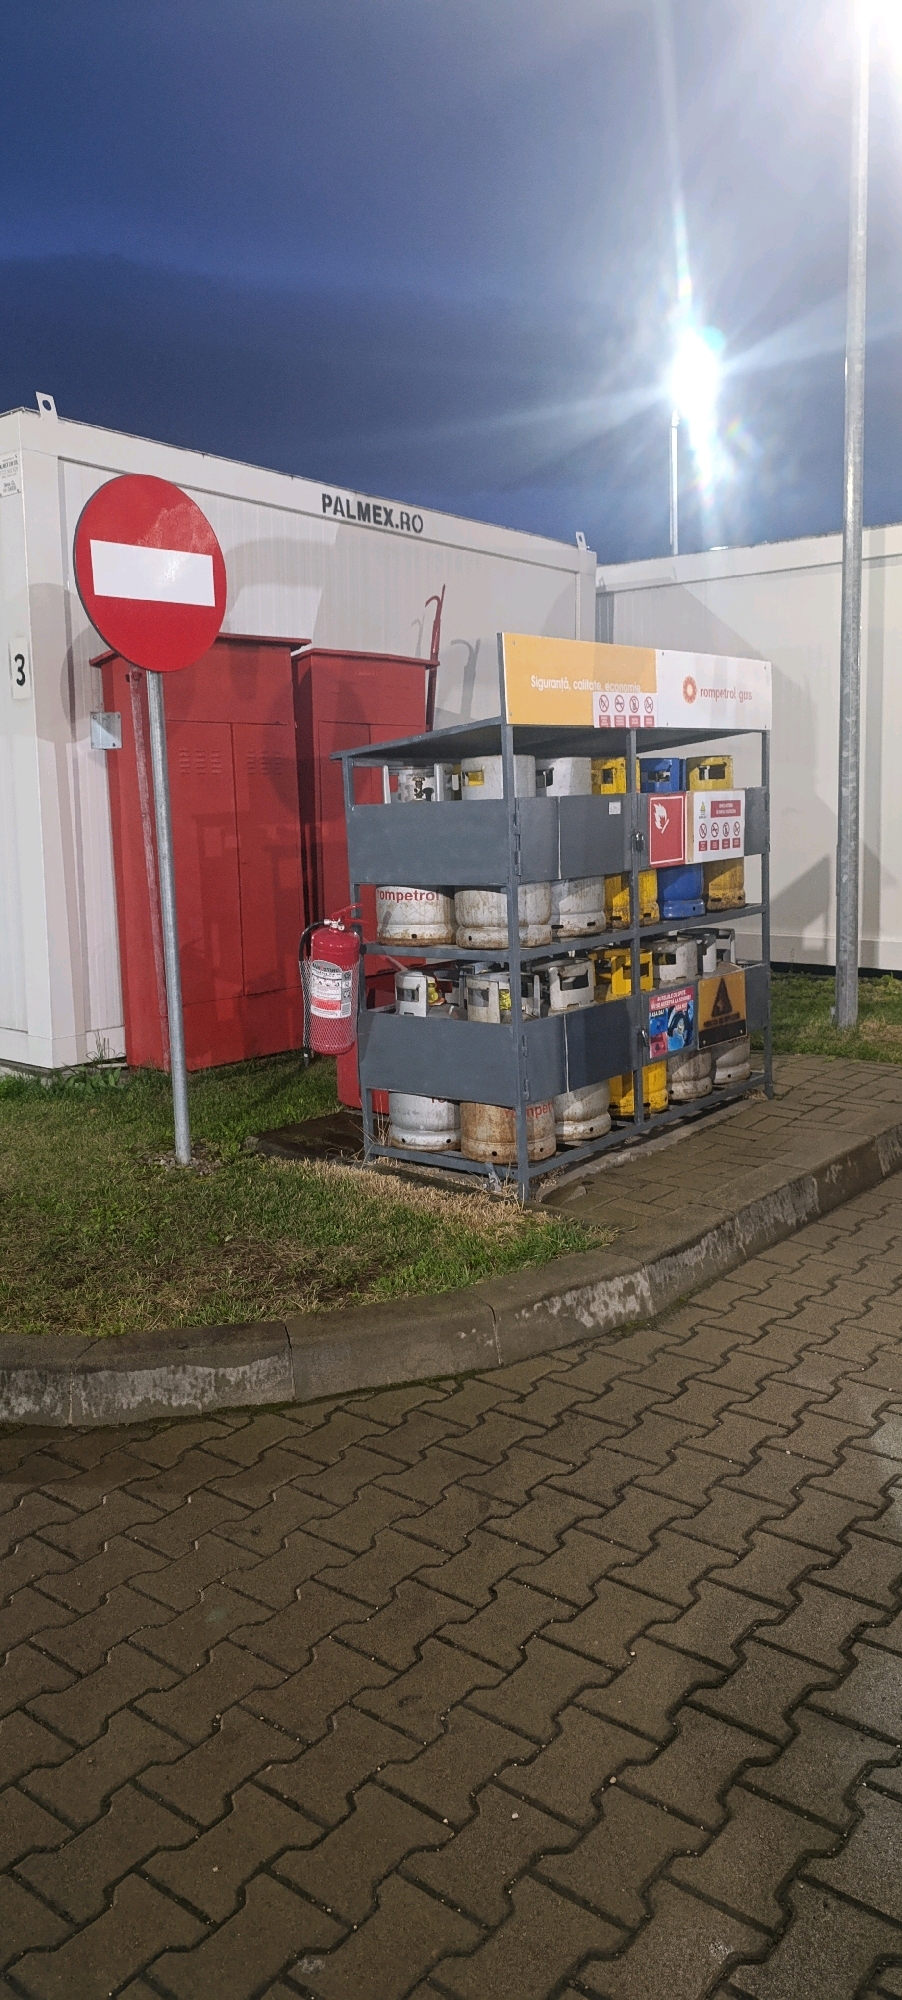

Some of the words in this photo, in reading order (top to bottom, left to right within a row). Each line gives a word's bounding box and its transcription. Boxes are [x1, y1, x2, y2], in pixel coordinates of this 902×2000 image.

[321, 493, 424, 534] PALMEX.RO
[14, 653, 26, 687] 3
[573, 679, 603, 691] calitate,
[700, 686, 737, 702] rompetrol
[738, 690, 753, 703] gas
